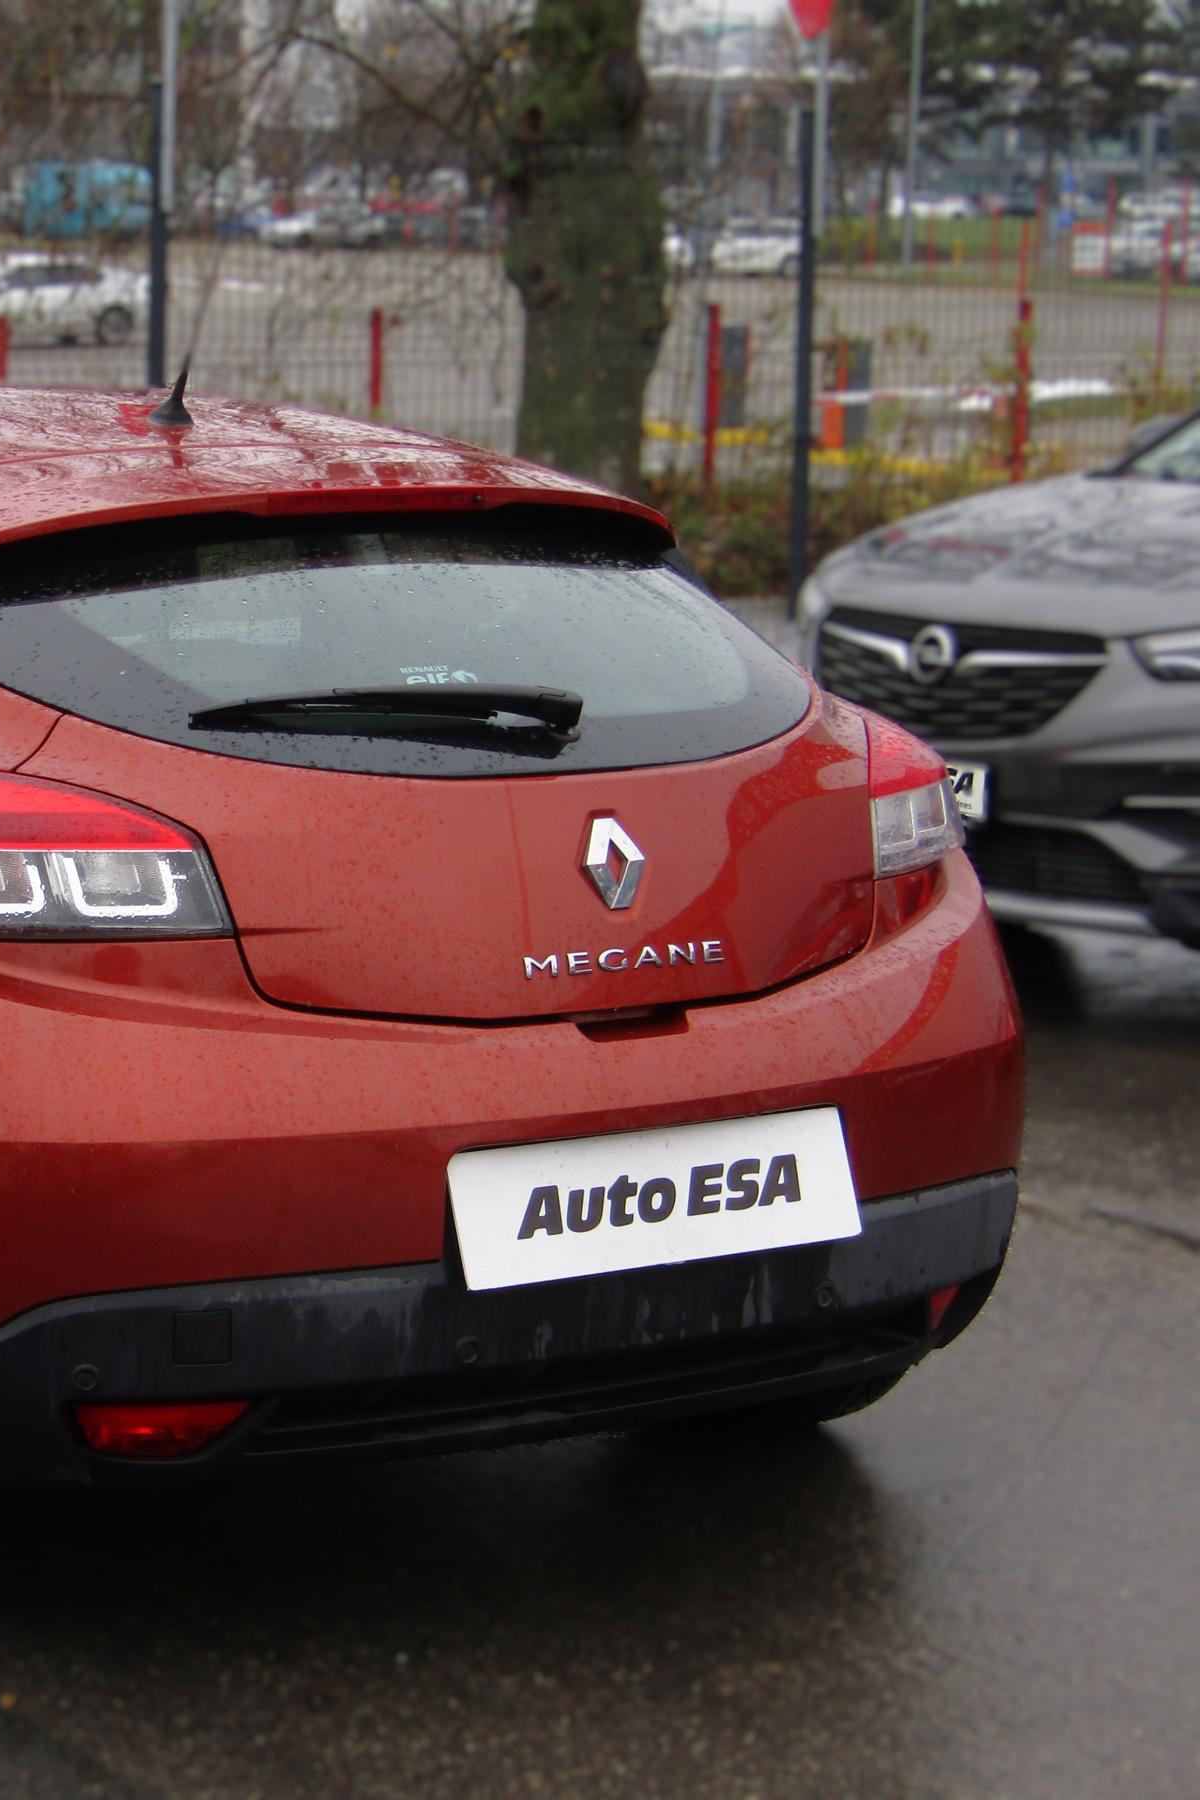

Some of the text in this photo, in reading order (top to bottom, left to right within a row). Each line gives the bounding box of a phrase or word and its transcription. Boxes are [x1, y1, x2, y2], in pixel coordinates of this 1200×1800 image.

[400, 664, 448, 673] RENAULT
[523, 940, 725, 979] MEGANE
[517, 1153, 801, 1240] Auto ESA
